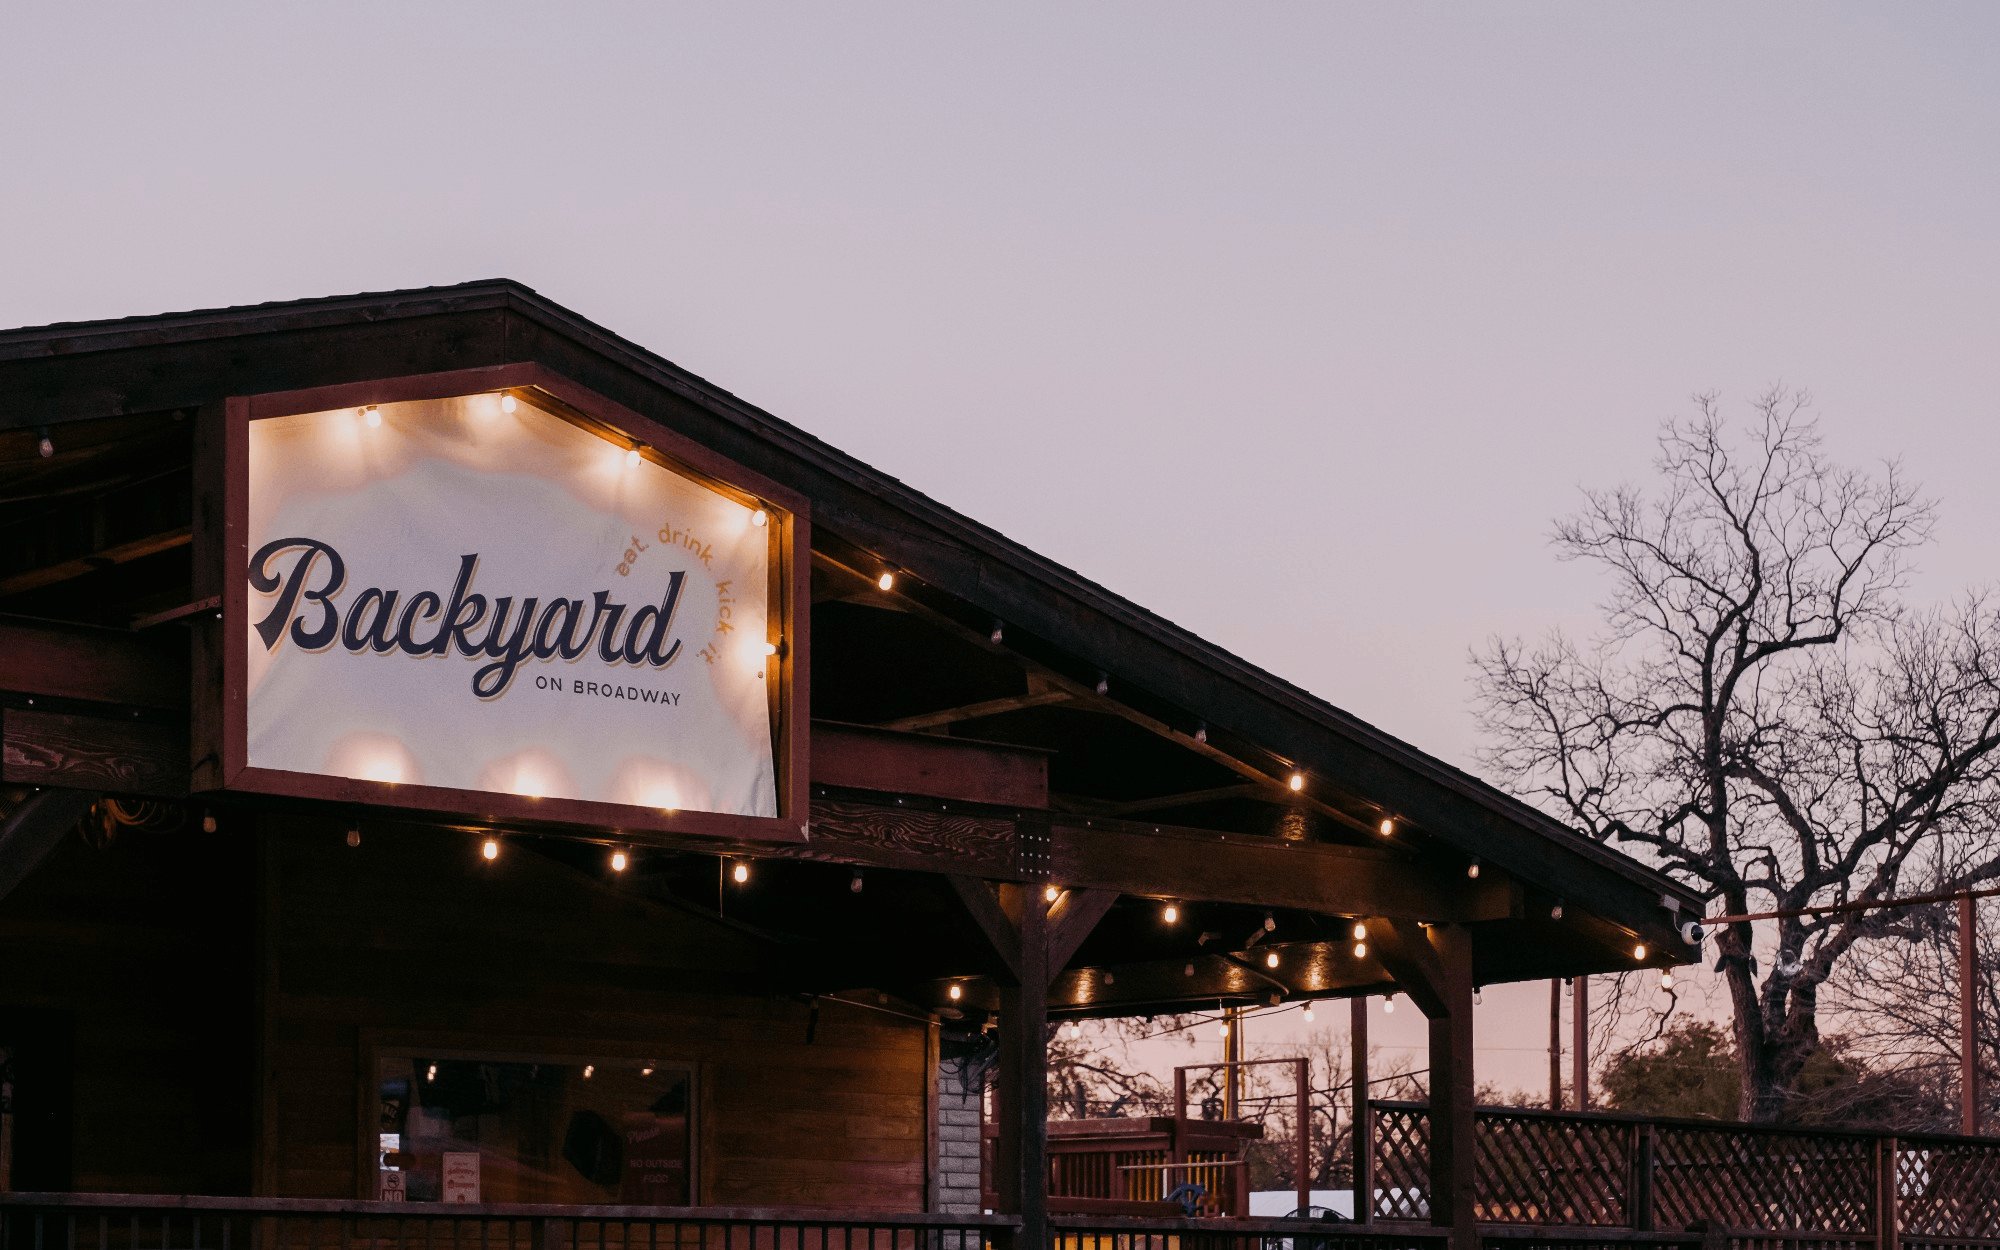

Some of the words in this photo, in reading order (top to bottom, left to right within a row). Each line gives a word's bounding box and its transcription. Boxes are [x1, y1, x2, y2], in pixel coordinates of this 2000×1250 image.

[248, 537, 685, 700] Backyard
[716, 580, 735, 635] kick
[535, 675, 562, 692] ON
[573, 680, 681, 706] BROADWAY
[645, 1159, 683, 1168] OUTSIDE
